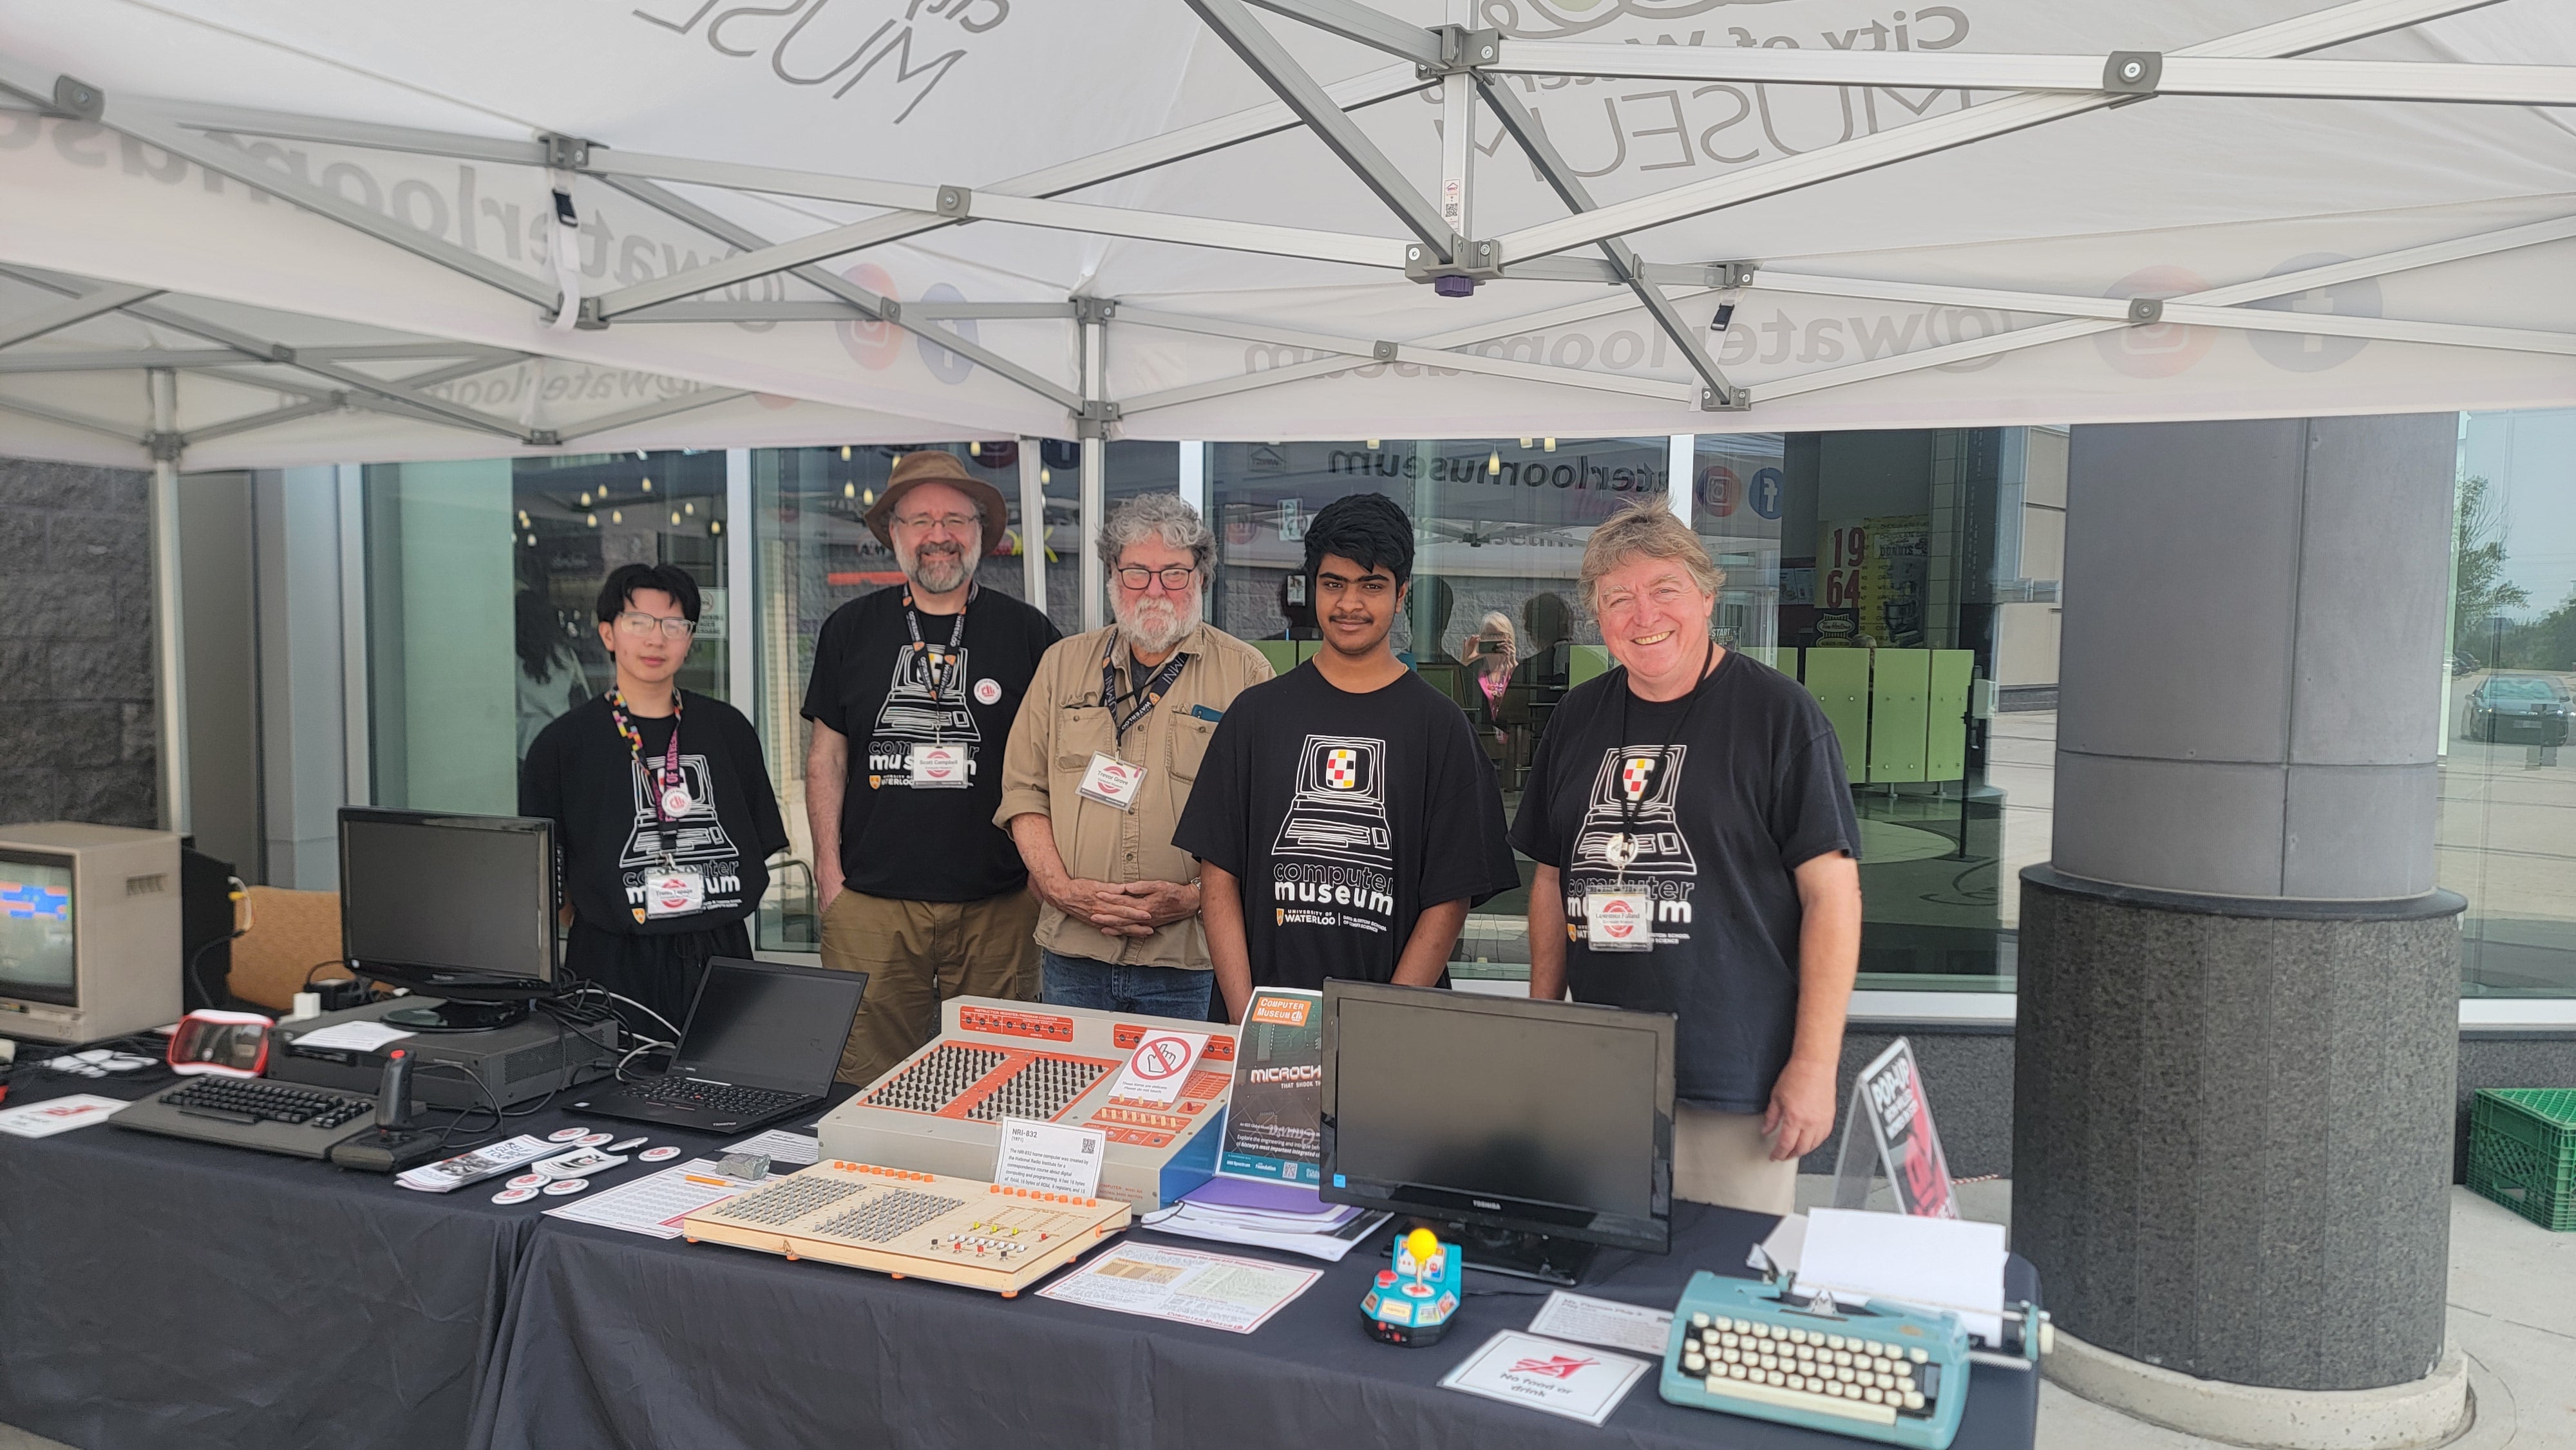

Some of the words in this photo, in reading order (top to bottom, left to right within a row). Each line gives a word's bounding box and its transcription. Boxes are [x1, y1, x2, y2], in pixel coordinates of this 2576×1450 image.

[1834, 527, 1865, 567] 19
[1826, 569, 1861, 608] 64
[1121, 701, 1152, 730] WATERLOO
[869, 740, 980, 760] comr
[869, 754, 977, 775] musm
[1097, 771, 1113, 780] Trevor
[1113, 777, 1128, 786] Grove
[622, 859, 739, 887] coter
[625, 875, 741, 905] mum
[1567, 876, 1695, 901] comter
[1274, 881, 1394, 916] museum
[1285, 914, 1336, 925] WATERLOO
[1371, 921, 1387, 931] SCHOOL
[1260, 998, 1304, 1010] COMPUTER
[1256, 1008, 1290, 1019] MUSEUM
[1869, 1057, 1911, 1114] POP-UP
[1012, 1128, 1037, 1138] NRI-832
[1260, 1136, 1285, 1146] engineering
[1270, 1145, 1292, 1154] important
[1292, 1149, 1316, 1157] integrated
[1007, 1163, 1036, 1171] correspondence
[1473, 1200, 1501, 1210] TOSHIBA
[1499, 1372, 1520, 1382] No
[1522, 1378, 1555, 1390] food
[1510, 1385, 1547, 1397] drink
